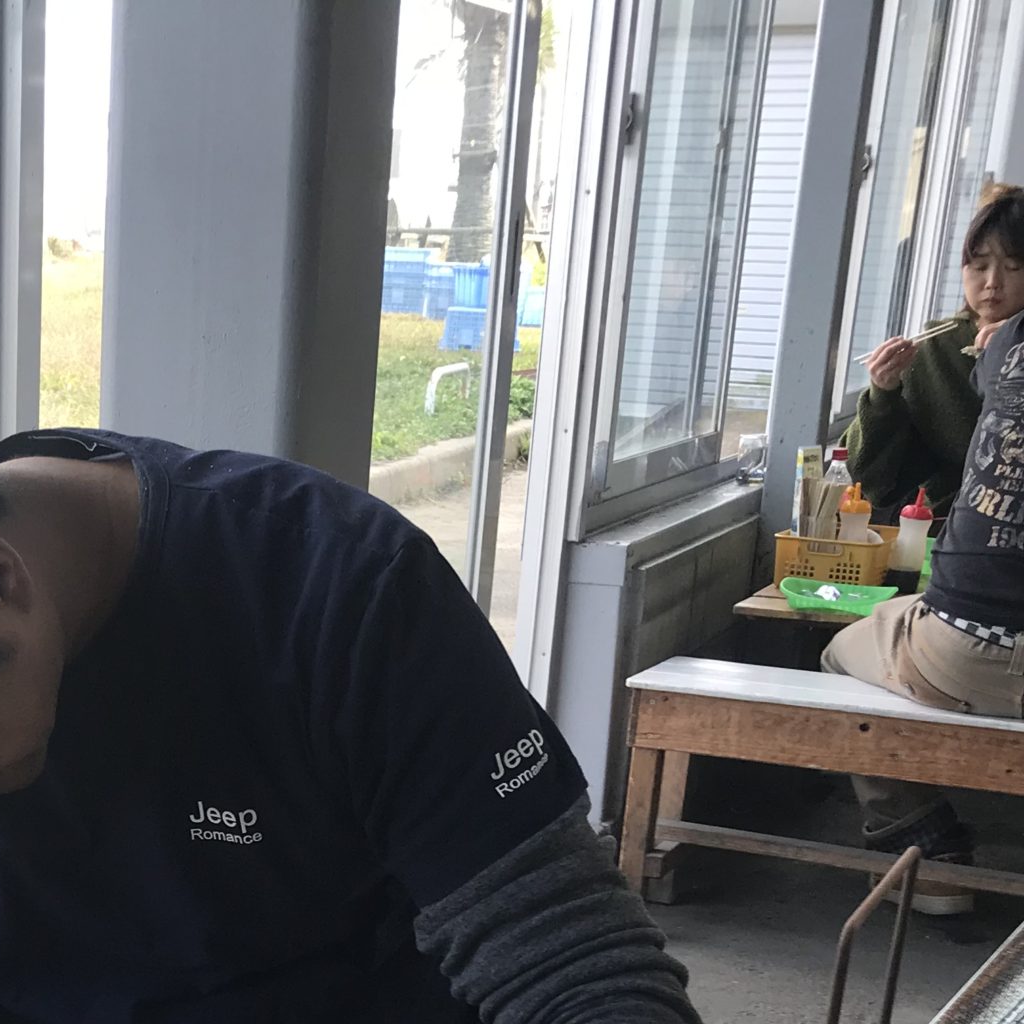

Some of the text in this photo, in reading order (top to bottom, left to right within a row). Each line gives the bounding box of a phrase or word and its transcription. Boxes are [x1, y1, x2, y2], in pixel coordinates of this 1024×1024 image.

[490, 728, 545, 780] Jeep
[495, 752, 549, 799] Romance
[189, 801, 257, 833] Jeep
[190, 828, 263, 844] Romance
